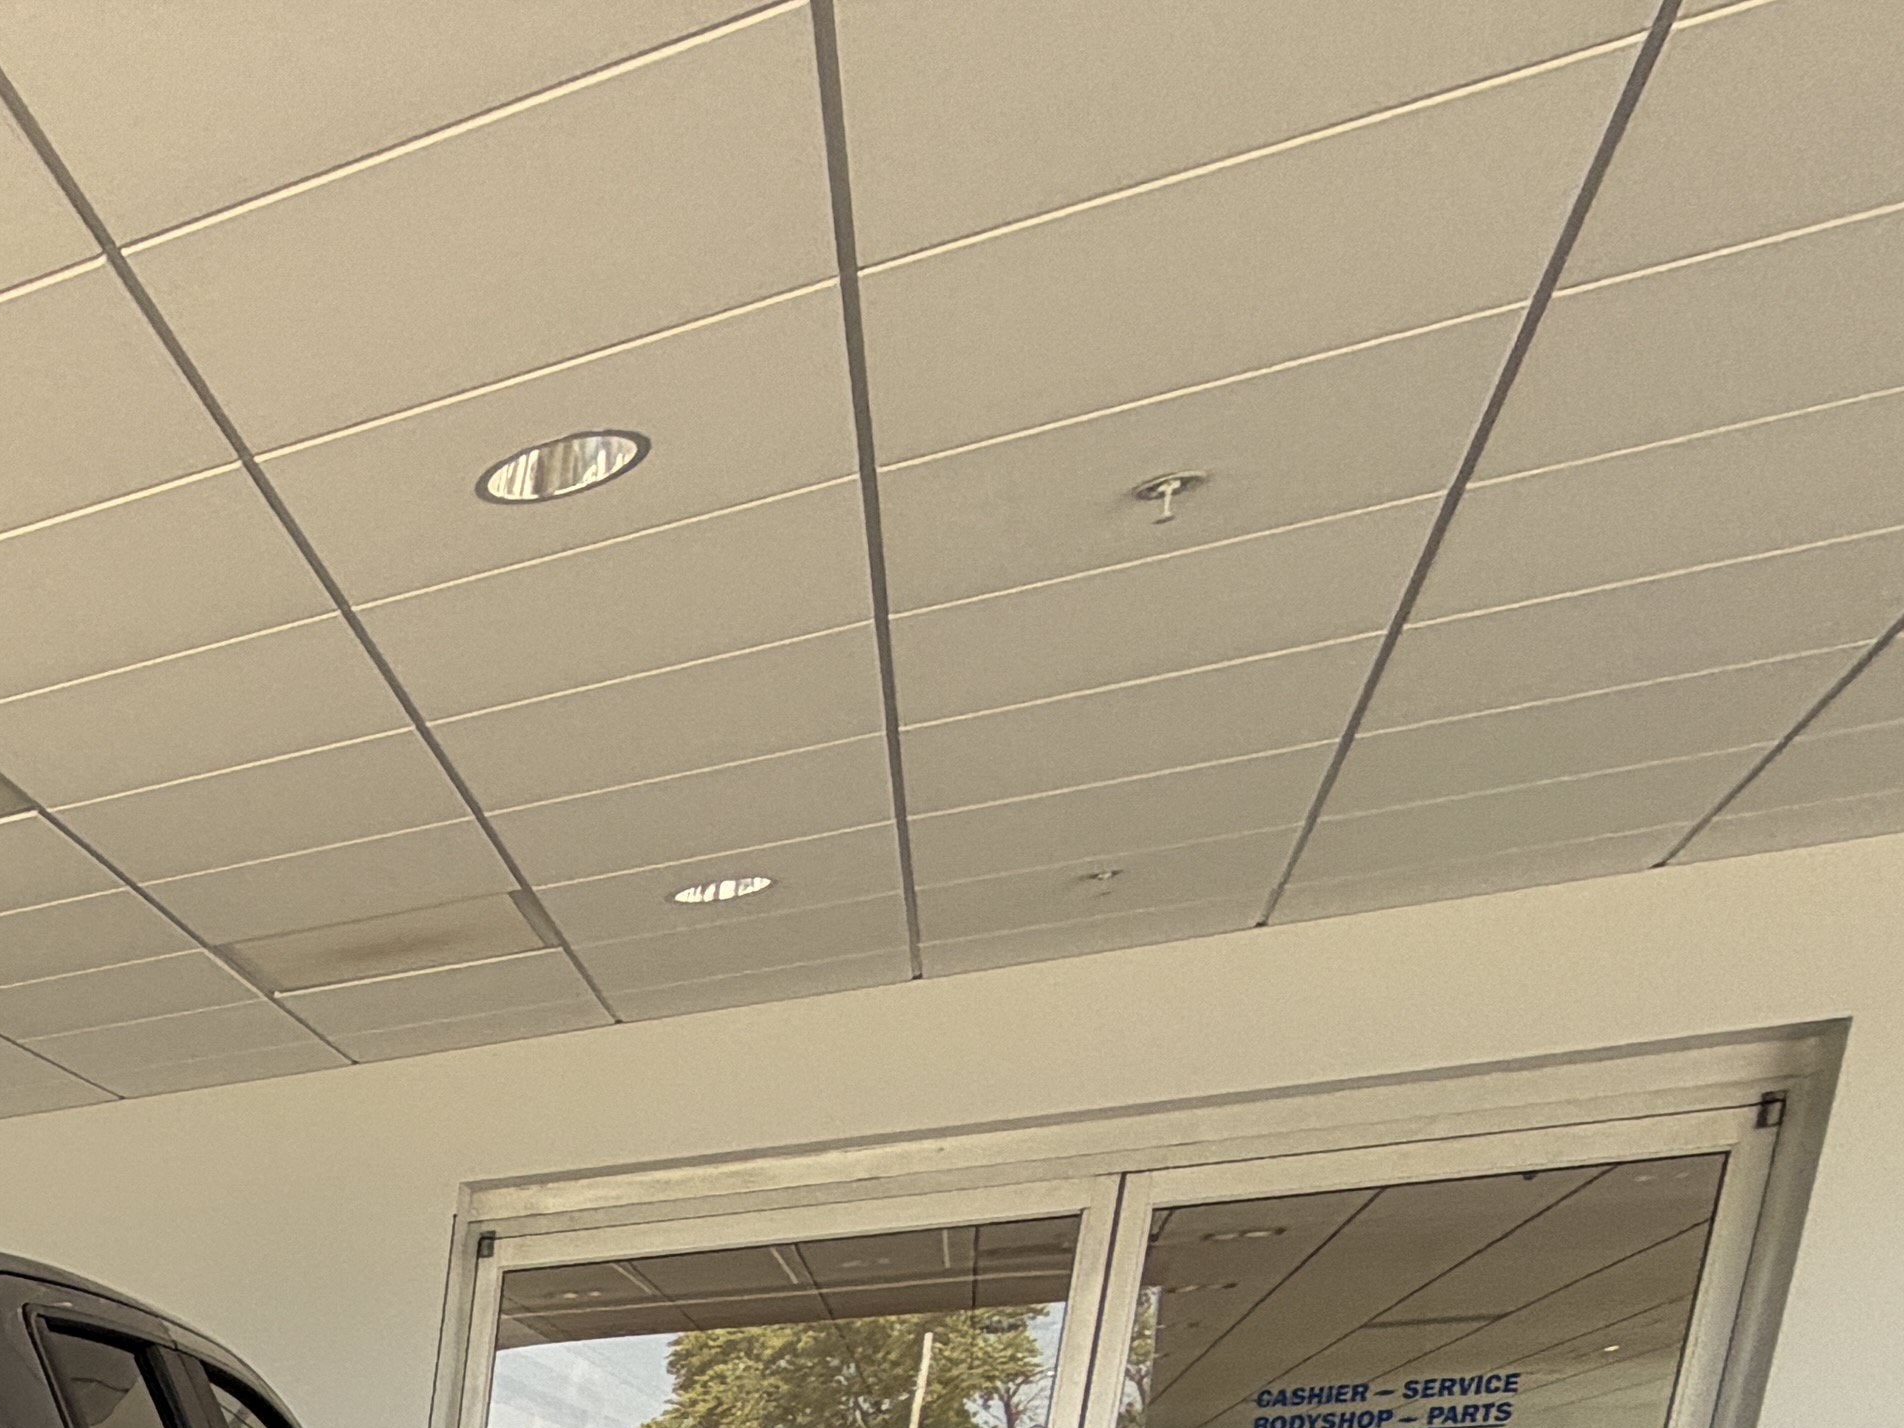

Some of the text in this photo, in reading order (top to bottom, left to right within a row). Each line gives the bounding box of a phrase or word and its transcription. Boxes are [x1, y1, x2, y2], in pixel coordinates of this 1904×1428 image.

[1255, 1382, 1370, 1408] CASHIER
[1402, 1372, 1521, 1400] SERVICE
[1427, 1401, 1513, 1426] PARTS
